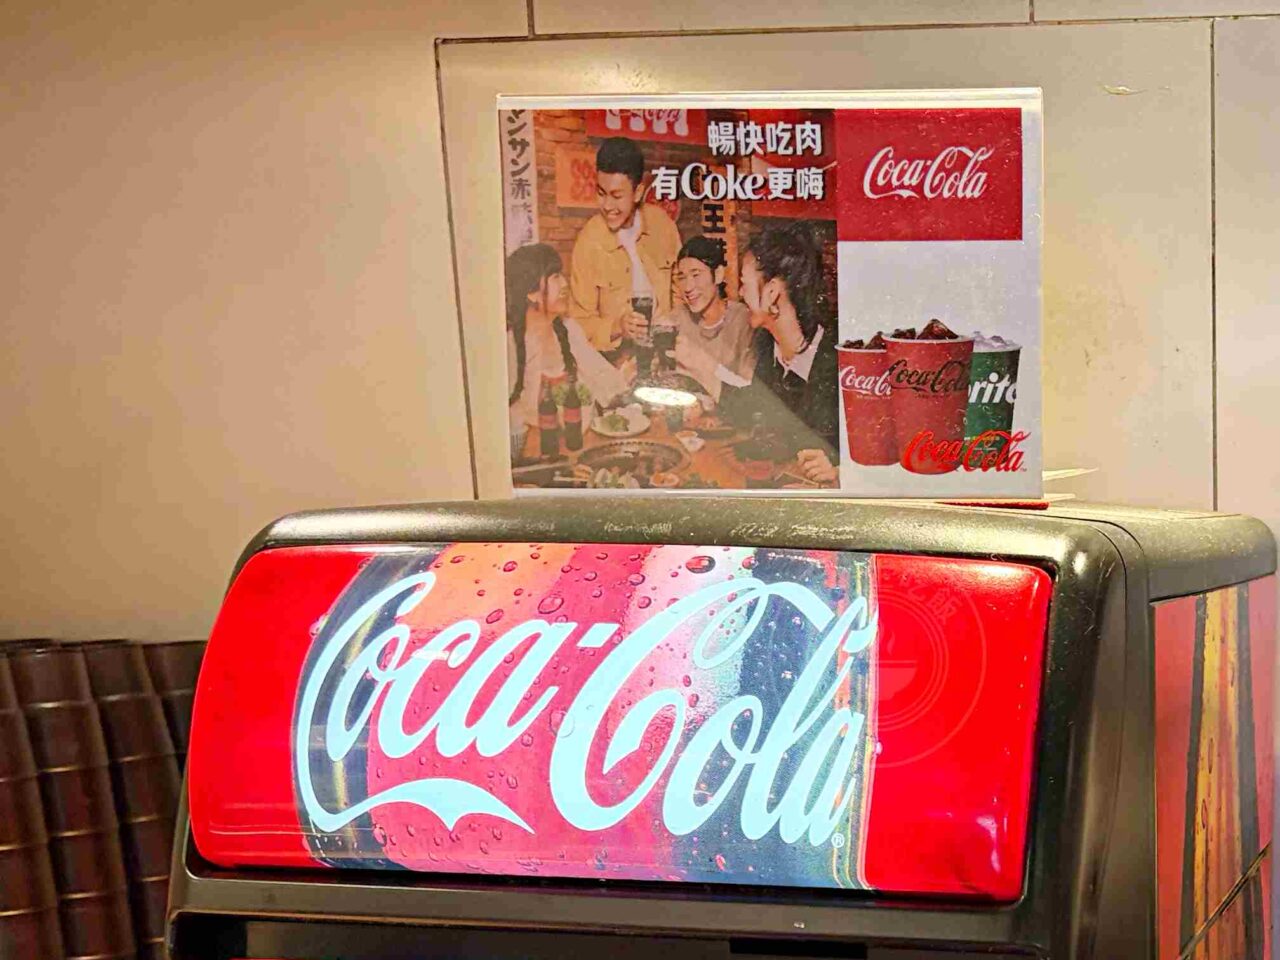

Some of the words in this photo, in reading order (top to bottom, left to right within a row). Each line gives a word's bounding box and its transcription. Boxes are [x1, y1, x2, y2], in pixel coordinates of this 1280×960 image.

[707, 121, 822, 156] 暢快吃肉
[863, 147, 995, 200] Coca-Cola
[903, 429, 1031, 473] Coca-Cola
[294, 572, 871, 844] Coca-Cola
